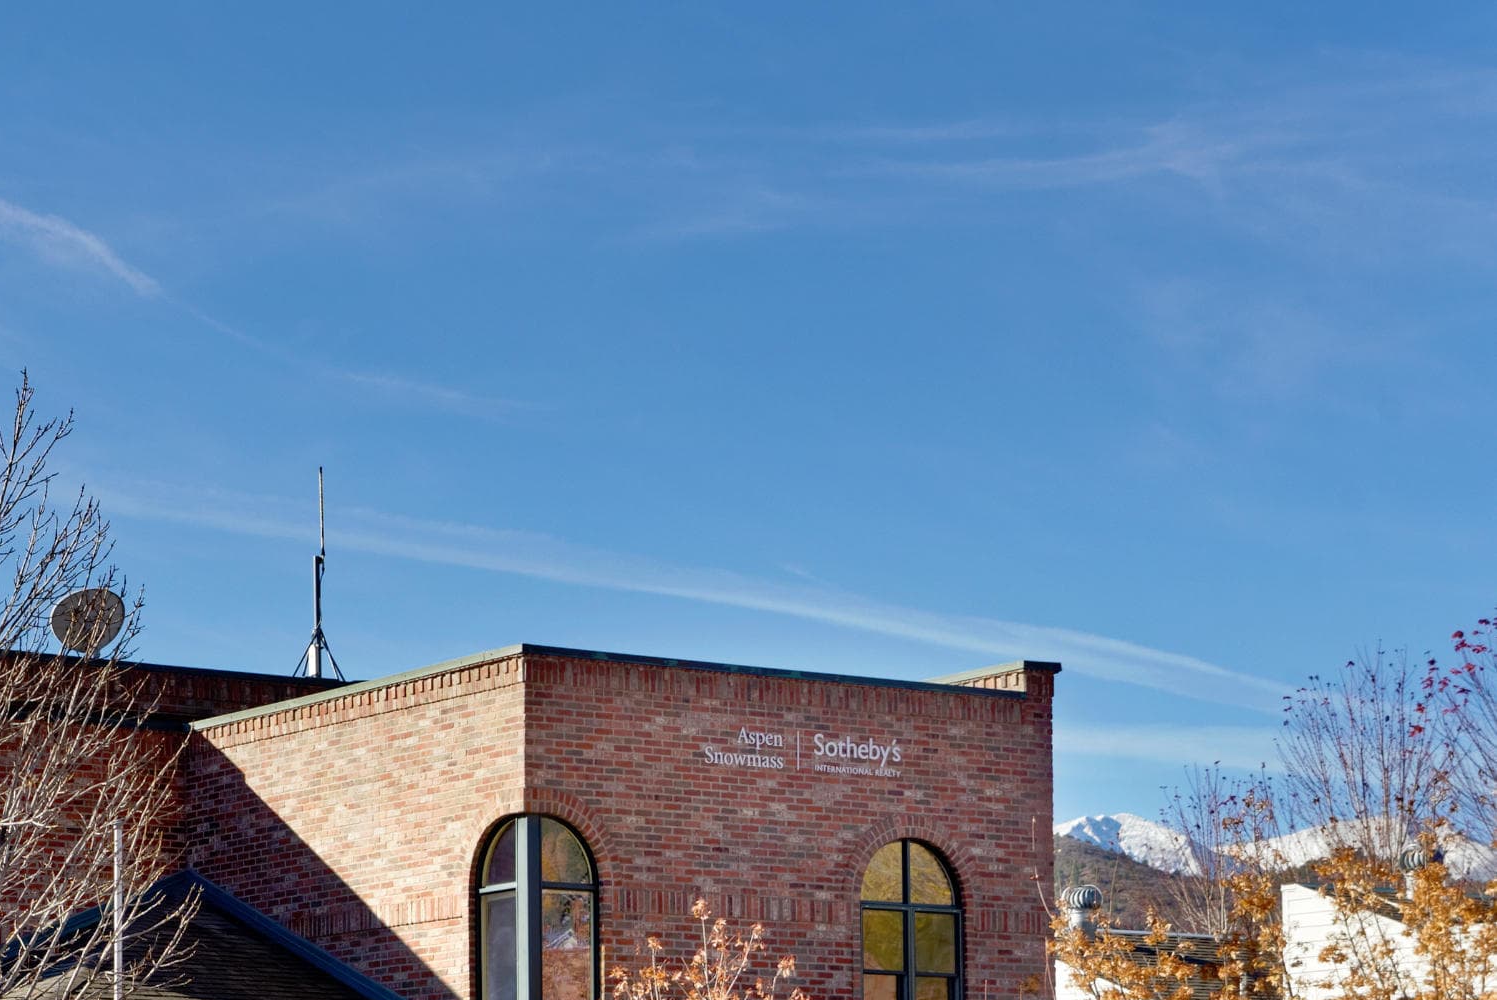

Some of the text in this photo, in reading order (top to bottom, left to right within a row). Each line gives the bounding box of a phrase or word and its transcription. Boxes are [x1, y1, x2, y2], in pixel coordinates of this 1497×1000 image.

[737, 726, 783, 750] Aspen
[704, 746, 784, 769] Snowmass
[813, 733, 901, 768] Sotheby's
[814, 764, 902, 778] INTERNATIONAL REALTY
